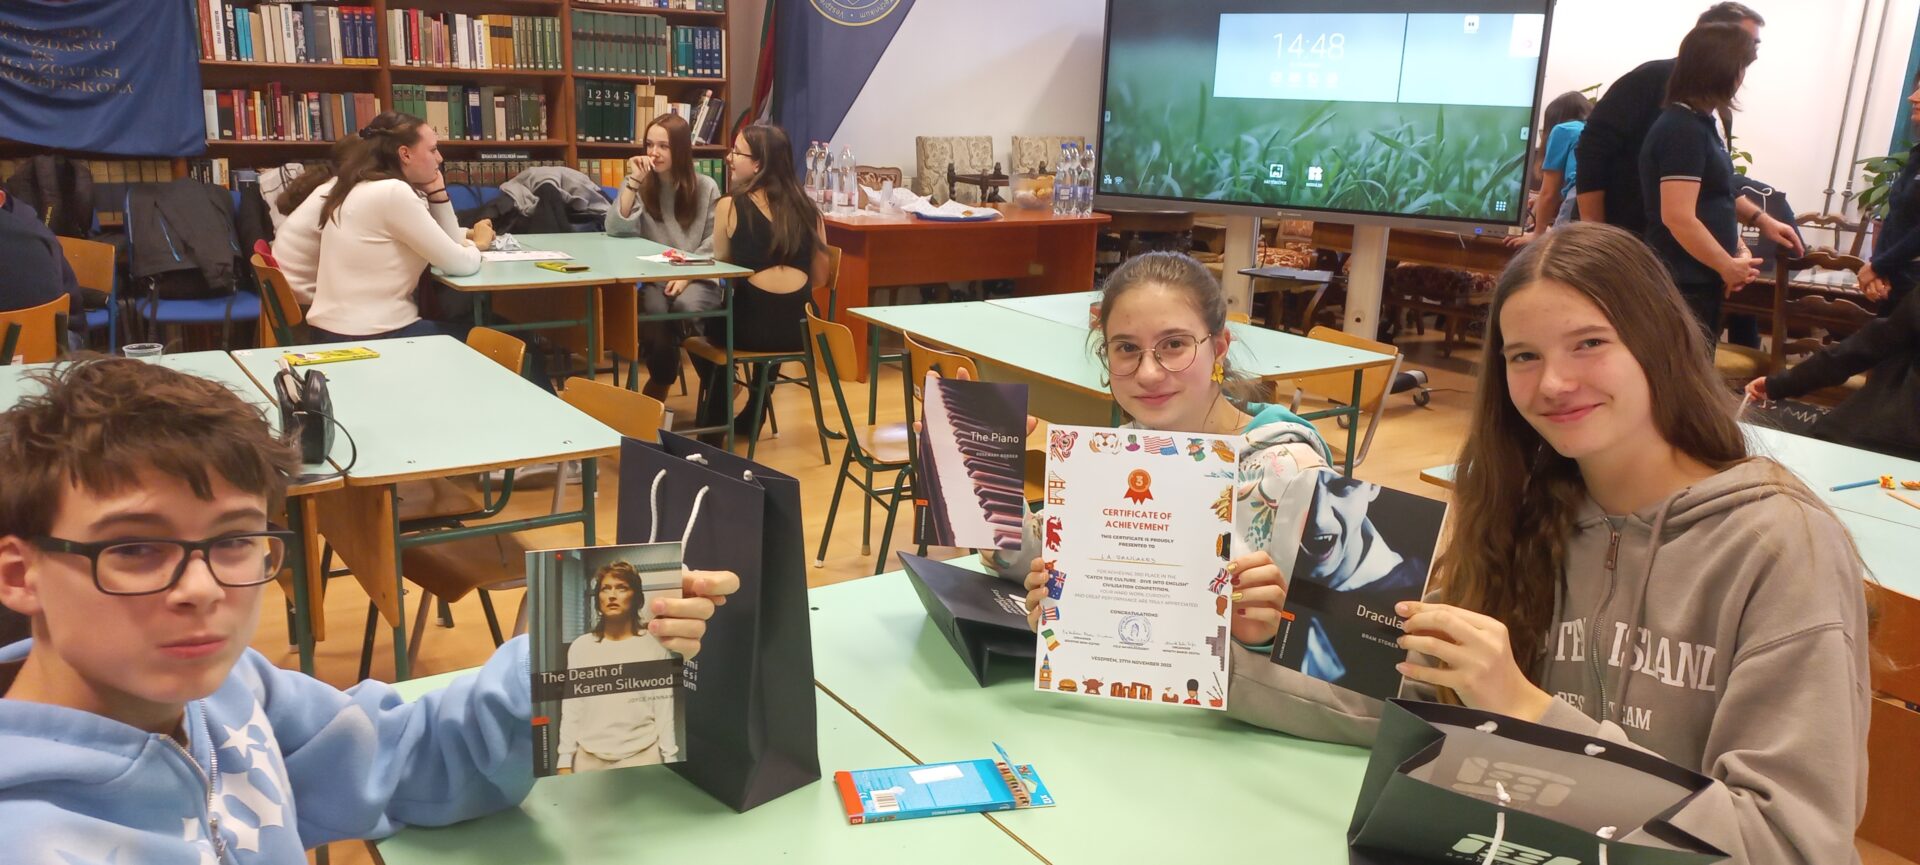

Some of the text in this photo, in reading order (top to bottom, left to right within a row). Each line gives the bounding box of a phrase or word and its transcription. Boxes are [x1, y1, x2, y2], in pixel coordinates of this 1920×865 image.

[1273, 32, 1345, 60] 14:48
[588, 89, 592, 98] 1
[595, 90, 601, 99] 2
[604, 89, 610, 98] 3
[613, 91, 619, 100] 4
[623, 91, 629, 100] 5
[971, 431, 1019, 444] The Piano
[1102, 508, 1172, 520] CERTIFICATE OF
[1105, 520, 1169, 532] ACHIEVEMENT
[1356, 604, 1404, 630] Dracula
[1361, 633, 1399, 649] BRAM STOKER
[540, 664, 623, 684] The Death of
[683, 667, 697, 681] ési
[573, 674, 673, 695] Karen Silkwood
[683, 680, 697, 691] um
[1608, 700, 1653, 731] TAM
